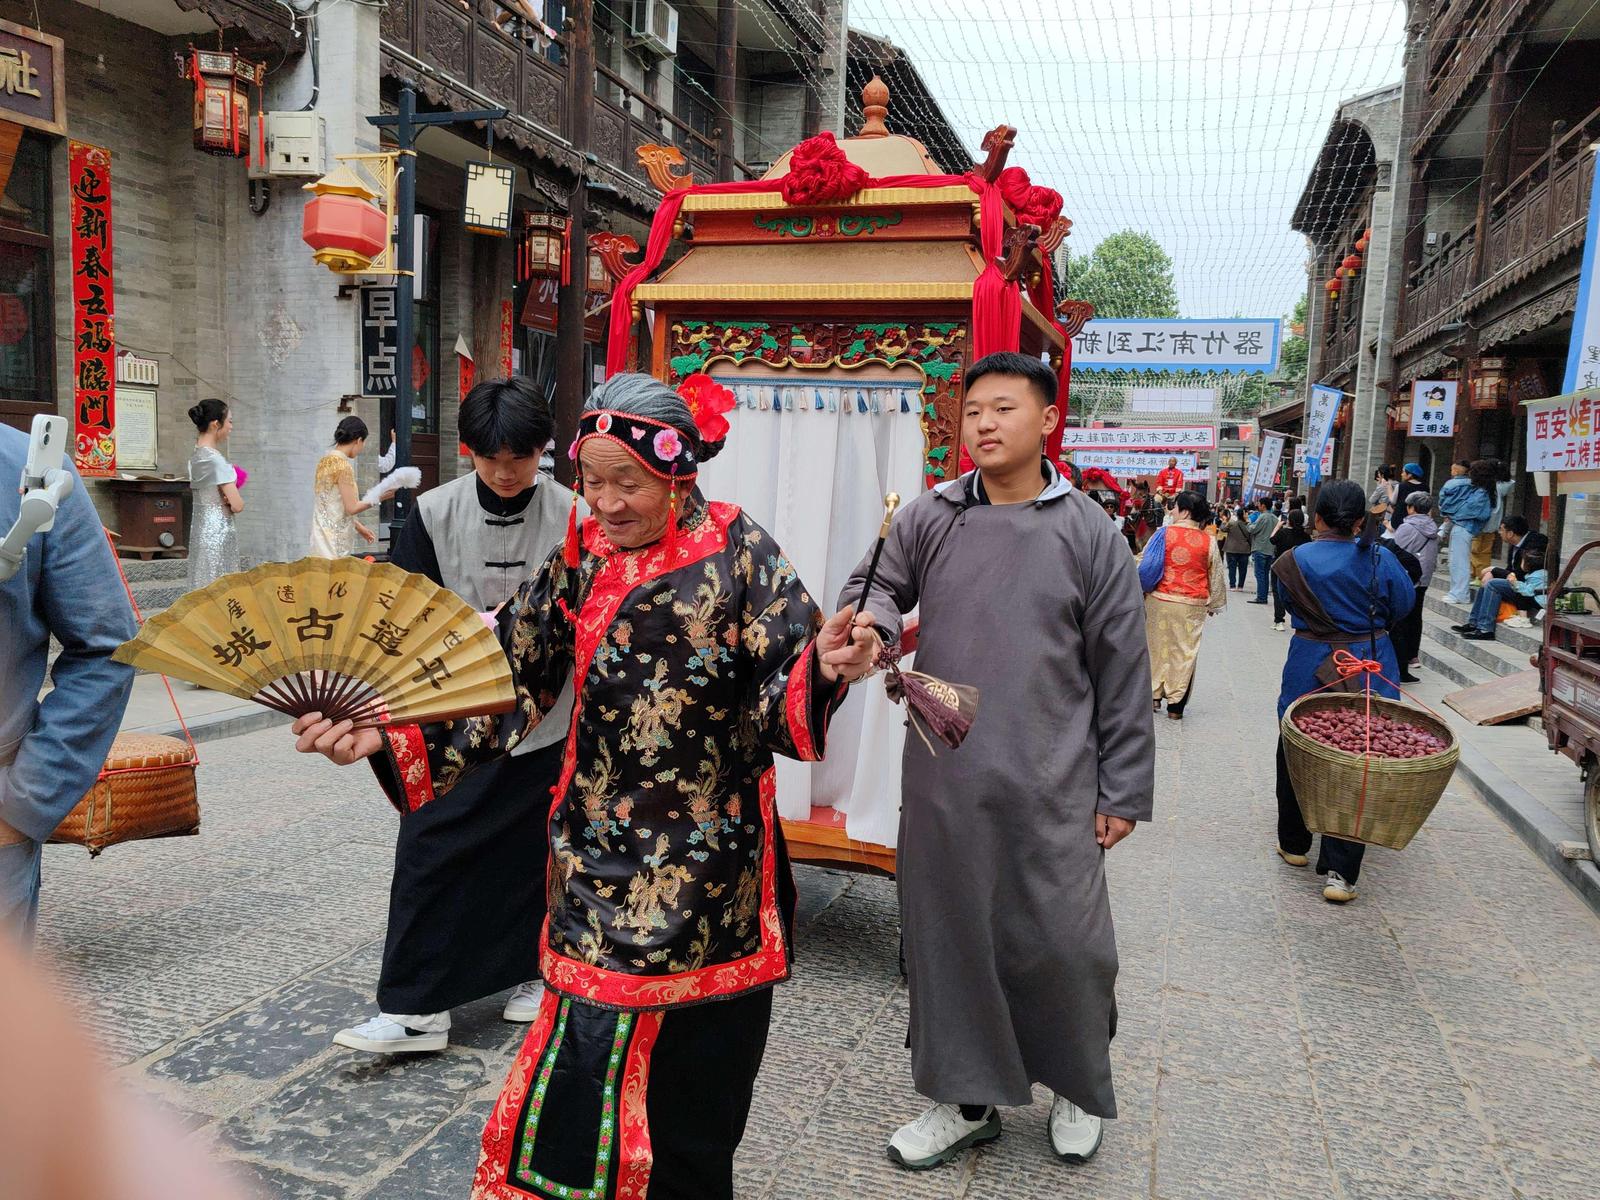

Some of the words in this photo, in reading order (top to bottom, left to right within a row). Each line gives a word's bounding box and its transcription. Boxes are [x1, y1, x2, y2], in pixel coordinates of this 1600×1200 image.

[0, 48, 42, 98] 社
[365, 291, 398, 391] 早点
[1415, 424, 1450, 434] 三明治
[1422, 411, 1445, 421] 寿司
